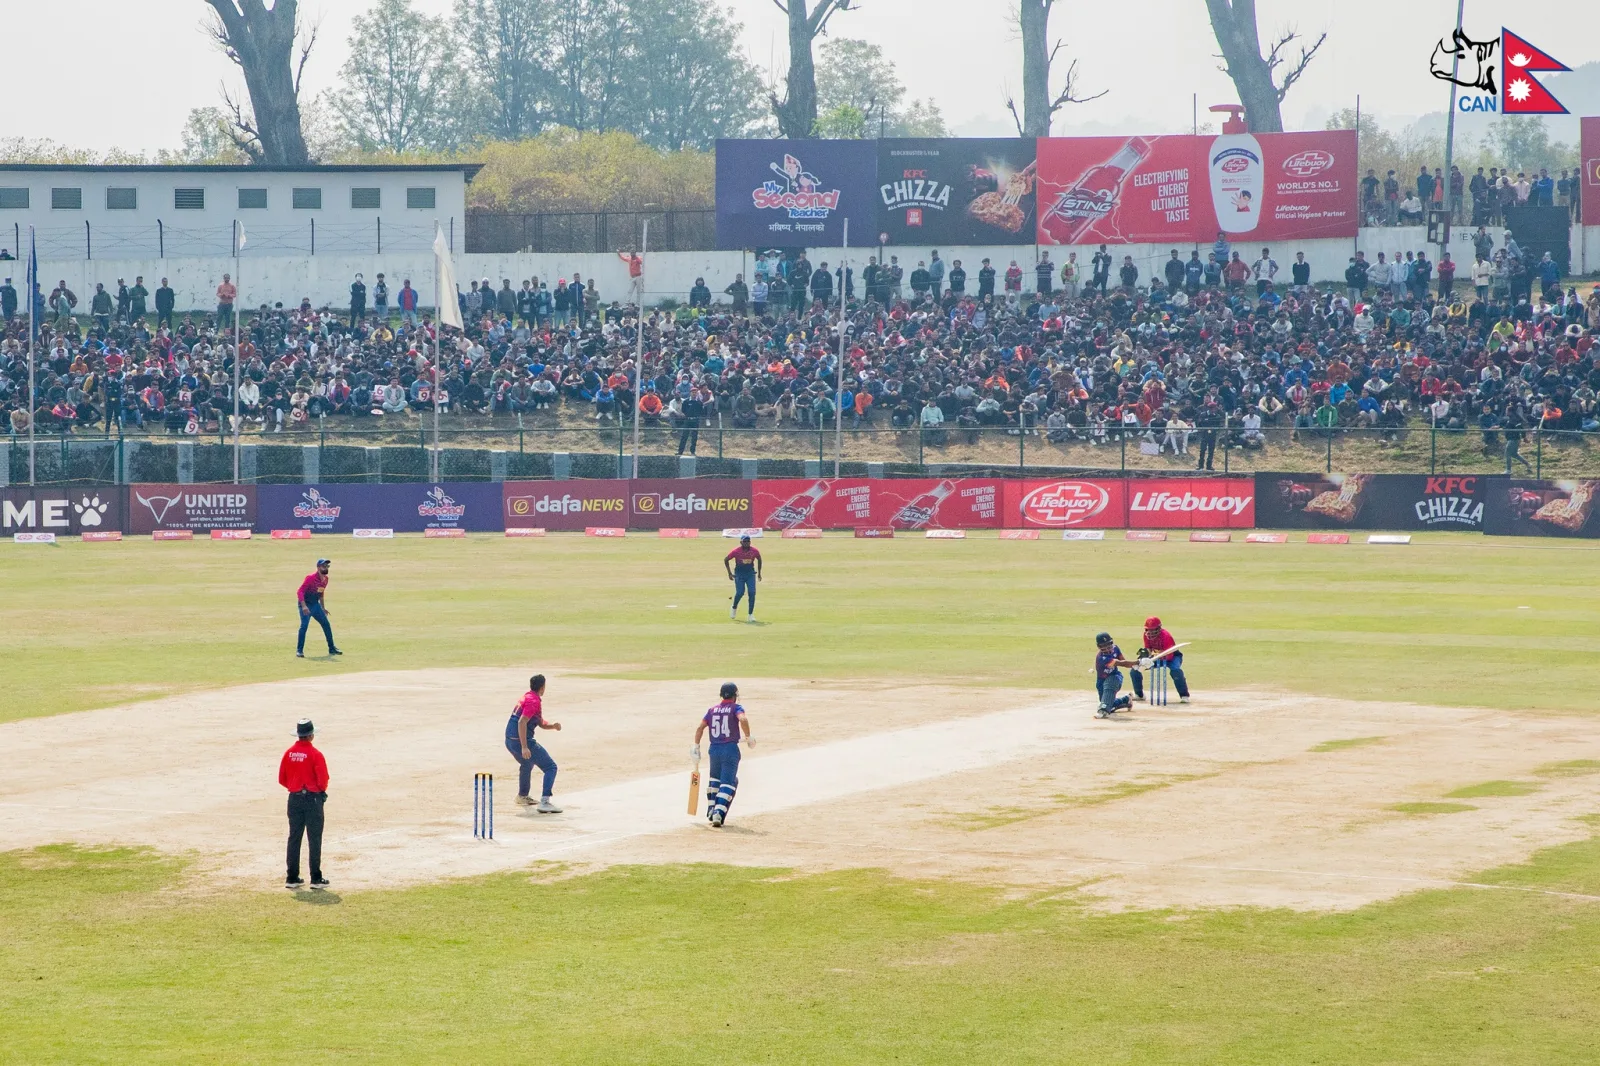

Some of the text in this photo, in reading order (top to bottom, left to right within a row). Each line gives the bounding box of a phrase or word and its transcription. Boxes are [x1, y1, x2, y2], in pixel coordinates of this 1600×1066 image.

[1288, 159, 1328, 168] Lifebuoy
[903, 169, 928, 178] KFC
[1134, 168, 1189, 187] ELECTRIFYING
[763, 180, 784, 194] My
[1158, 182, 1189, 197] ENERGY
[1277, 181, 1316, 190] WORLD'S
[1319, 180, 1333, 188] NO.
[880, 179, 951, 206] CHIZZA
[752, 188, 840, 210] Second
[1151, 195, 1189, 211] ULTIMATE
[1063, 199, 1112, 212] STING
[1275, 204, 1310, 212] Lifebuoy
[788, 207, 829, 218] Teacher
[1165, 208, 1189, 222] TASTE
[1424, 477, 1476, 494] KFC
[836, 486, 870, 497] ELECTRIFYING
[961, 486, 995, 497] ELECTRIFYING
[185, 494, 247, 508] UNITED
[851, 494, 870, 503] ENERGY
[976, 494, 995, 503] ENERGY
[1031, 495, 1098, 510] Lifebuoy
[1130, 492, 1252, 515] Lifebuoy
[293, 506, 341, 517] Second
[418, 504, 465, 516] Second
[846, 502, 870, 511] ULTIMATE
[971, 502, 995, 511] ULTIMATE
[1415, 497, 1485, 523] CHIZZA
[3, 500, 69, 527] ME
[779, 511, 806, 520] STING
[855, 509, 870, 518] TASTE
[904, 511, 931, 520] STING
[980, 509, 995, 518] TASTE
[711, 715, 730, 738] 54
